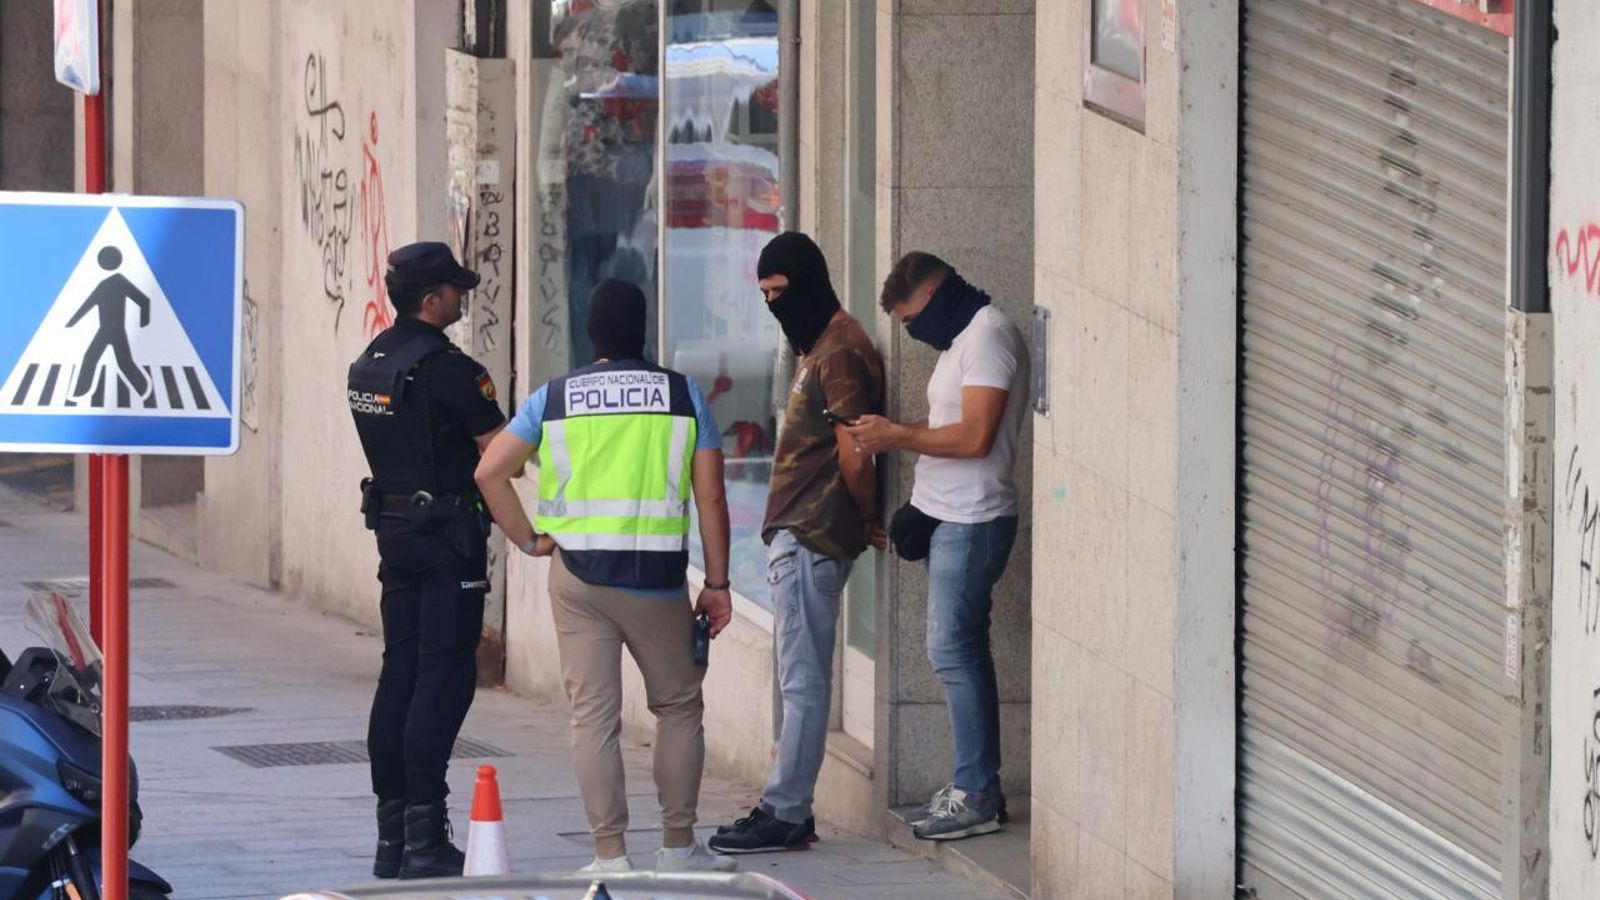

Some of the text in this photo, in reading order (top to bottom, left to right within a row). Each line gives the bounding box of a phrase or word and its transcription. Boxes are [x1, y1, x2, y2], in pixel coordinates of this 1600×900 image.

[570, 373, 665, 388] CUERPO NACIONAL DE
[348, 390, 380, 404] POLICIA
[569, 388, 665, 411] POLICIA
